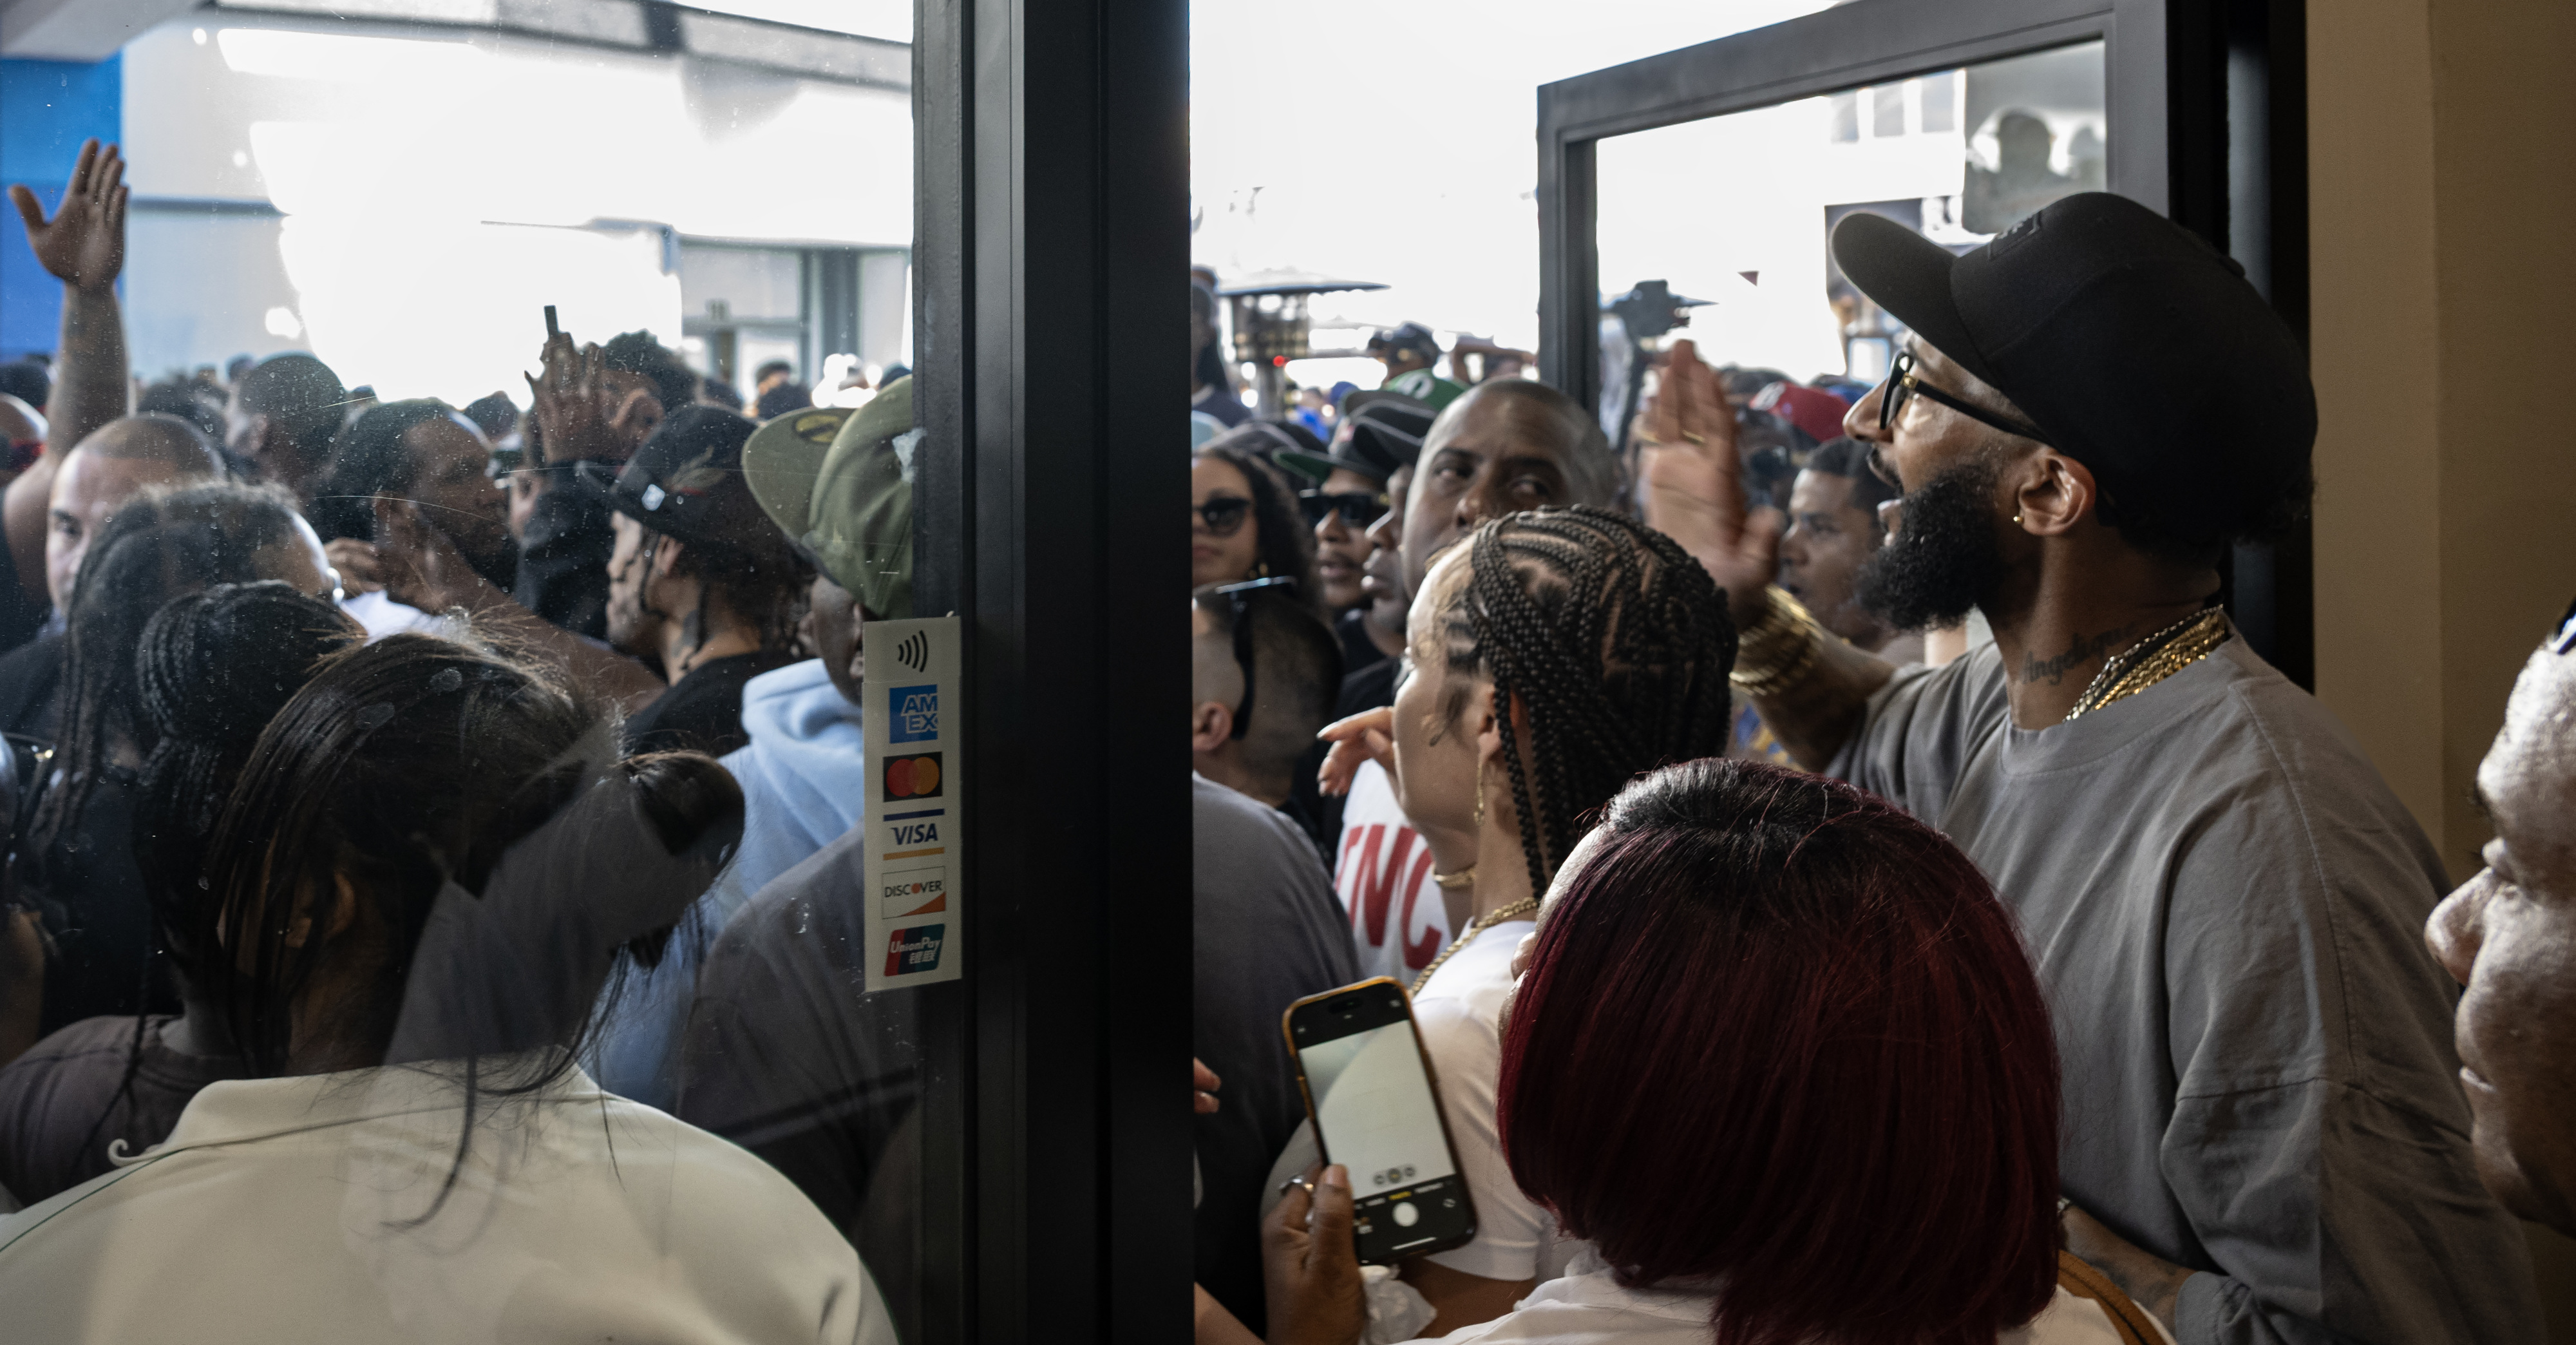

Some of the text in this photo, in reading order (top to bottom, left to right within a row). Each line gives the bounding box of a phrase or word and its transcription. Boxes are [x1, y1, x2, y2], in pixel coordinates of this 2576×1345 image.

[901, 693, 938, 716] AM
[906, 712, 938, 733] EX
[890, 823, 938, 845] VISA
[884, 880, 942, 898] DISCOVER
[890, 937, 942, 954] UnionPay
